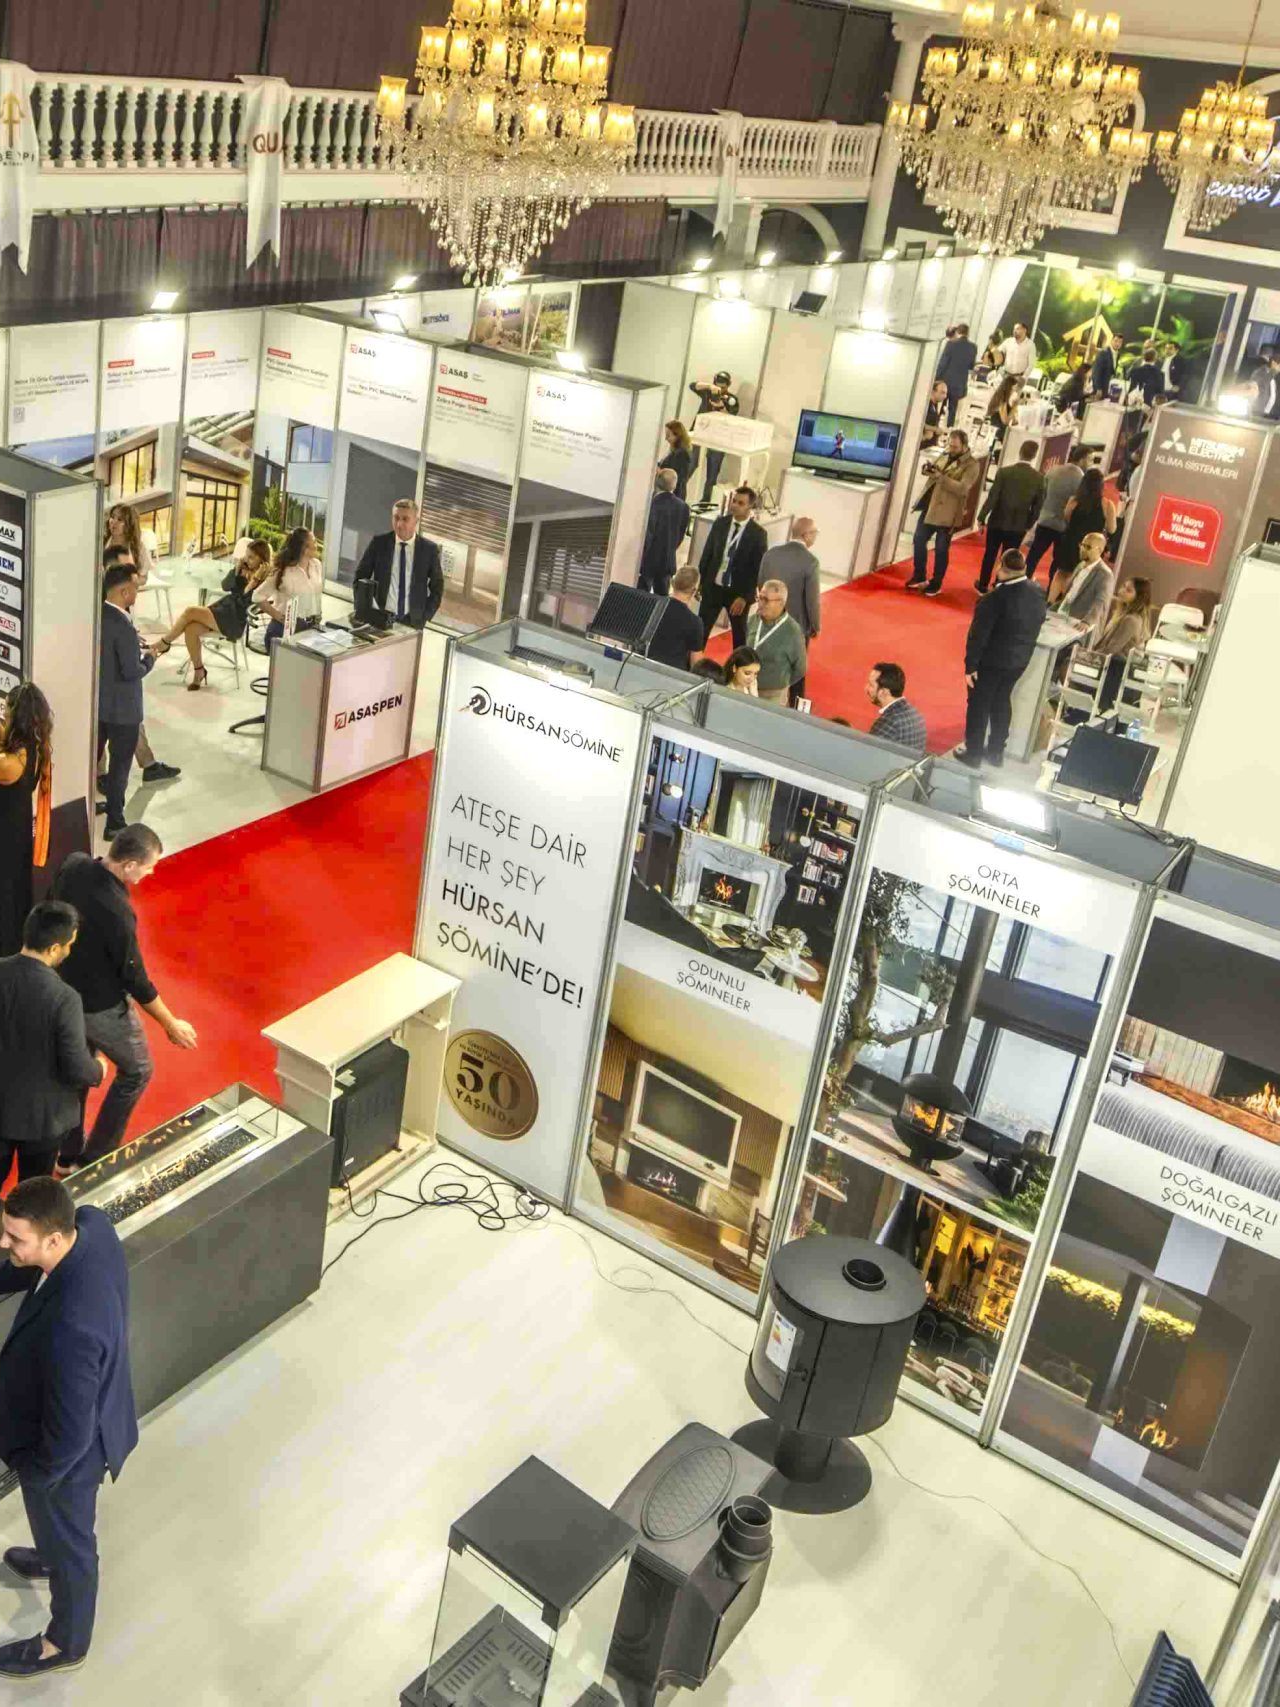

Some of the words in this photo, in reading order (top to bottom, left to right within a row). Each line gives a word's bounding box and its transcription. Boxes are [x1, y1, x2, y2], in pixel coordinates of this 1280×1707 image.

[348, 694, 403, 724] ASAŞPEN
[450, 794, 521, 842] ATEŞE
[531, 823, 588, 869] DAİR
[447, 836, 492, 875] HER
[500, 855, 546, 896] ŞEY
[977, 864, 1020, 890] ORTA
[441, 879, 545, 945] HÜRSAN
[948, 873, 1041, 919] ŞÖMİNELER
[437, 921, 584, 1010] ŞÖMİNE'DE!
[677, 970, 752, 1014] ŞÖMİNELER
[688, 959, 746, 993] ODUNLU
[457, 1052, 520, 1111] 50
[1160, 1165, 1279, 1227] DOĞALGAZLI
[1160, 1186, 1264, 1242] ŞÖMİNELER
